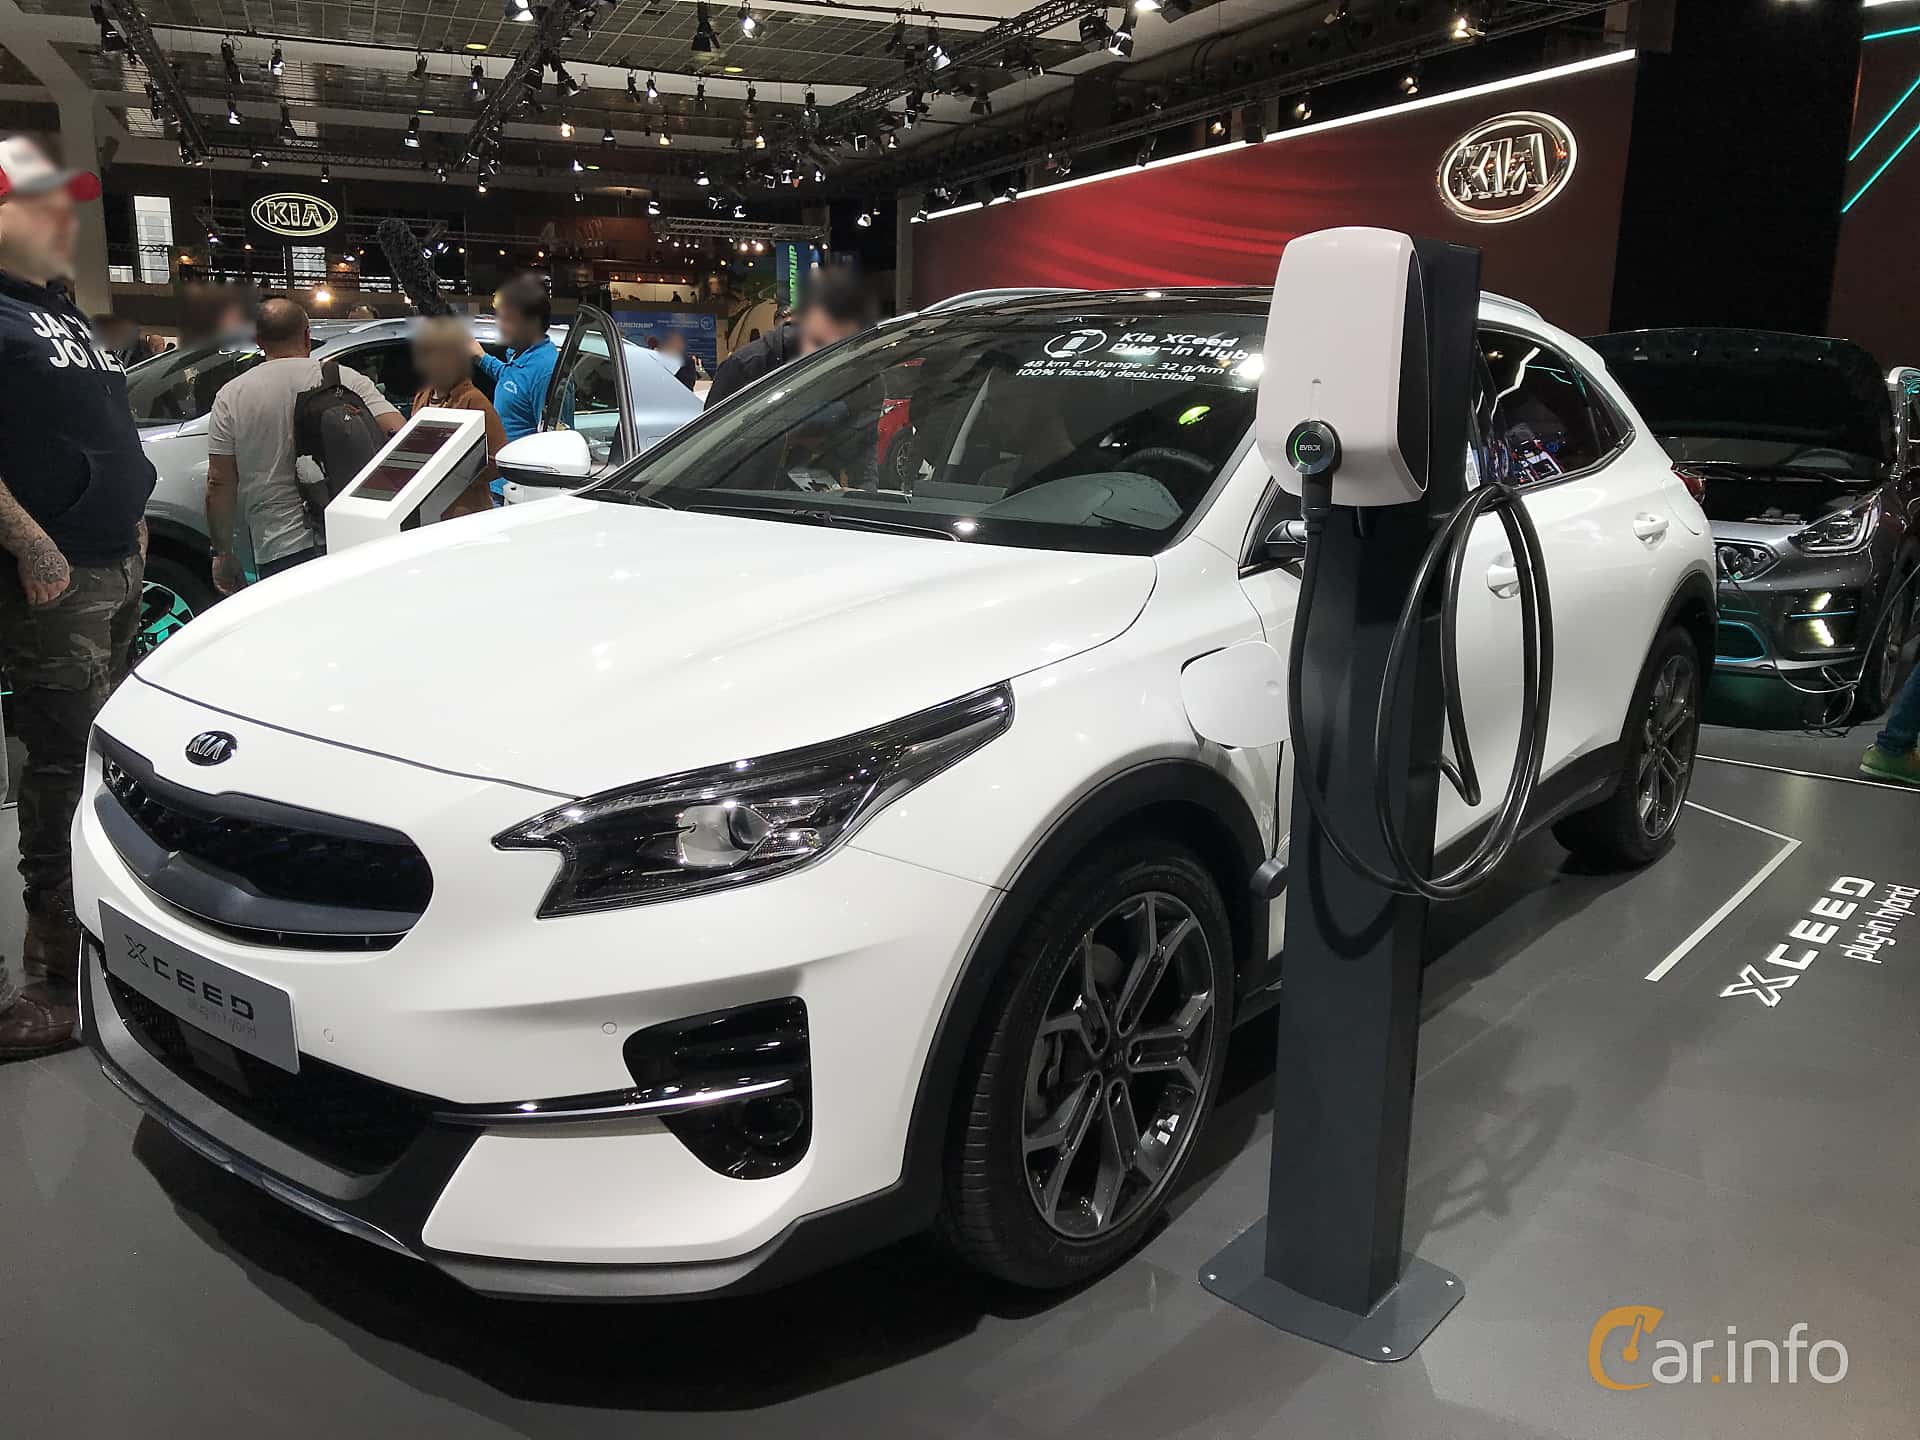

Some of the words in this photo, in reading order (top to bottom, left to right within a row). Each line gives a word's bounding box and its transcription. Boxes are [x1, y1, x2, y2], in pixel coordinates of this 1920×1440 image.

[1451, 133, 1549, 201] KIA
[266, 202, 324, 226] KIA
[1160, 333, 1239, 347] XCeed
[1072, 360, 1097, 368] EV
[1199, 346, 1259, 361] Hyb
[1058, 369, 1112, 378] fiscally
[1114, 369, 1197, 382] deductible
[187, 734, 228, 760] KIA
[1865, 884, 1920, 920] hybrid
[1719, 875, 1875, 1007] XCEED
[1839, 919, 1896, 964] plug-in
[124, 934, 255, 1020] XCEED
